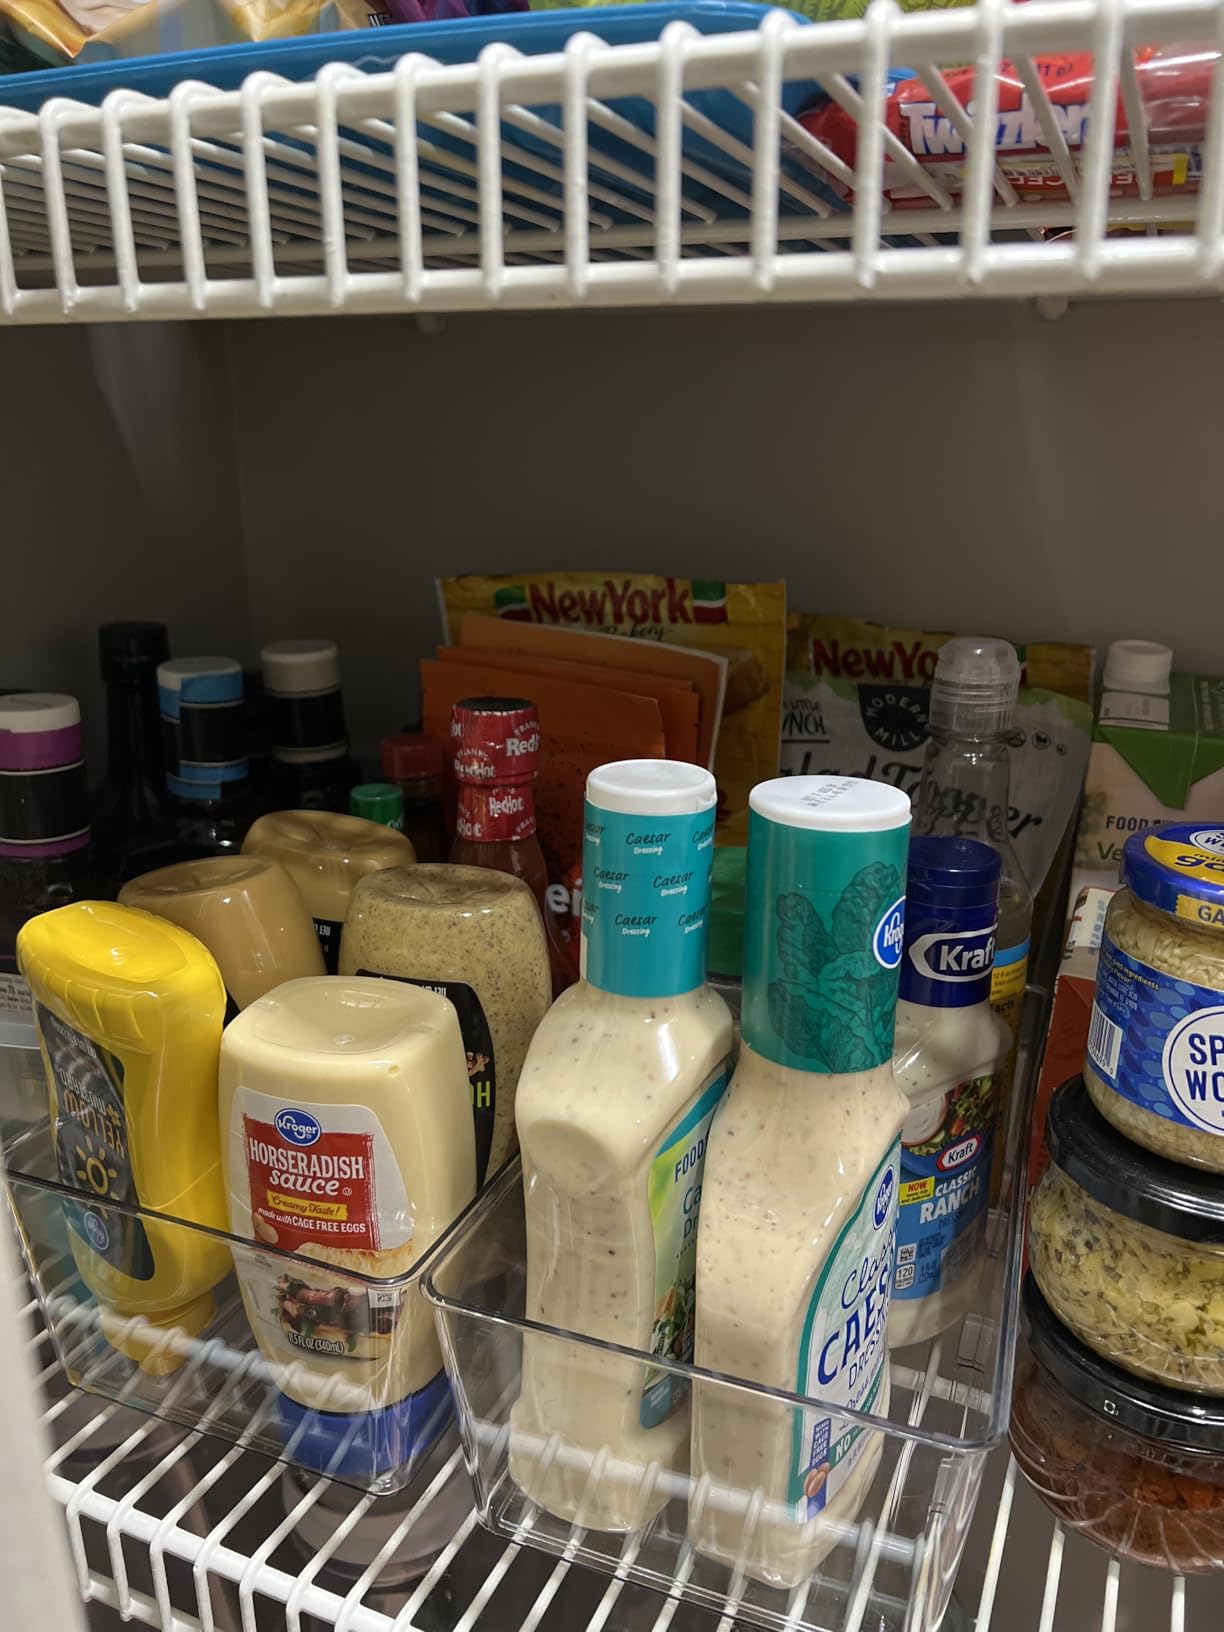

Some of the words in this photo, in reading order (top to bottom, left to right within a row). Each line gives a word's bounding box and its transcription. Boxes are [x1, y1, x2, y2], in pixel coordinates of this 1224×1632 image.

[864, 692, 929, 724] MODERN
[874, 727, 921, 747] MILL
[489, 795, 525, 818] RedHot
[626, 832, 671, 845] Caesar
[633, 846, 663, 855] Dressing
[593, 867, 630, 881] Caesar
[653, 871, 694, 888] Caesar
[615, 914, 658, 925] Caesar
[278, 1115, 317, 1139] Kroger
[249, 1138, 365, 1180] HORSERADISH
[675, 1138, 704, 1183] FOOD
[947, 1142, 974, 1164] Kraft
[269, 1169, 341, 1196] sauce
[908, 1180, 927, 1193] NOW
[935, 1165, 977, 1198] CLASSIC
[271, 1194, 308, 1213] Creamy
[308, 1203, 341, 1217] Taste!
[920, 1175, 980, 1225] RANCH
[257, 1207, 275, 1220] made
[276, 1214, 292, 1225] with
[292, 1215, 315, 1230] CAGE
[316, 1220, 339, 1232] FREE
[341, 1223, 366, 1233] EGGS
[898, 1266, 913, 1277] 120
[835, 1435, 851, 1463] NO
